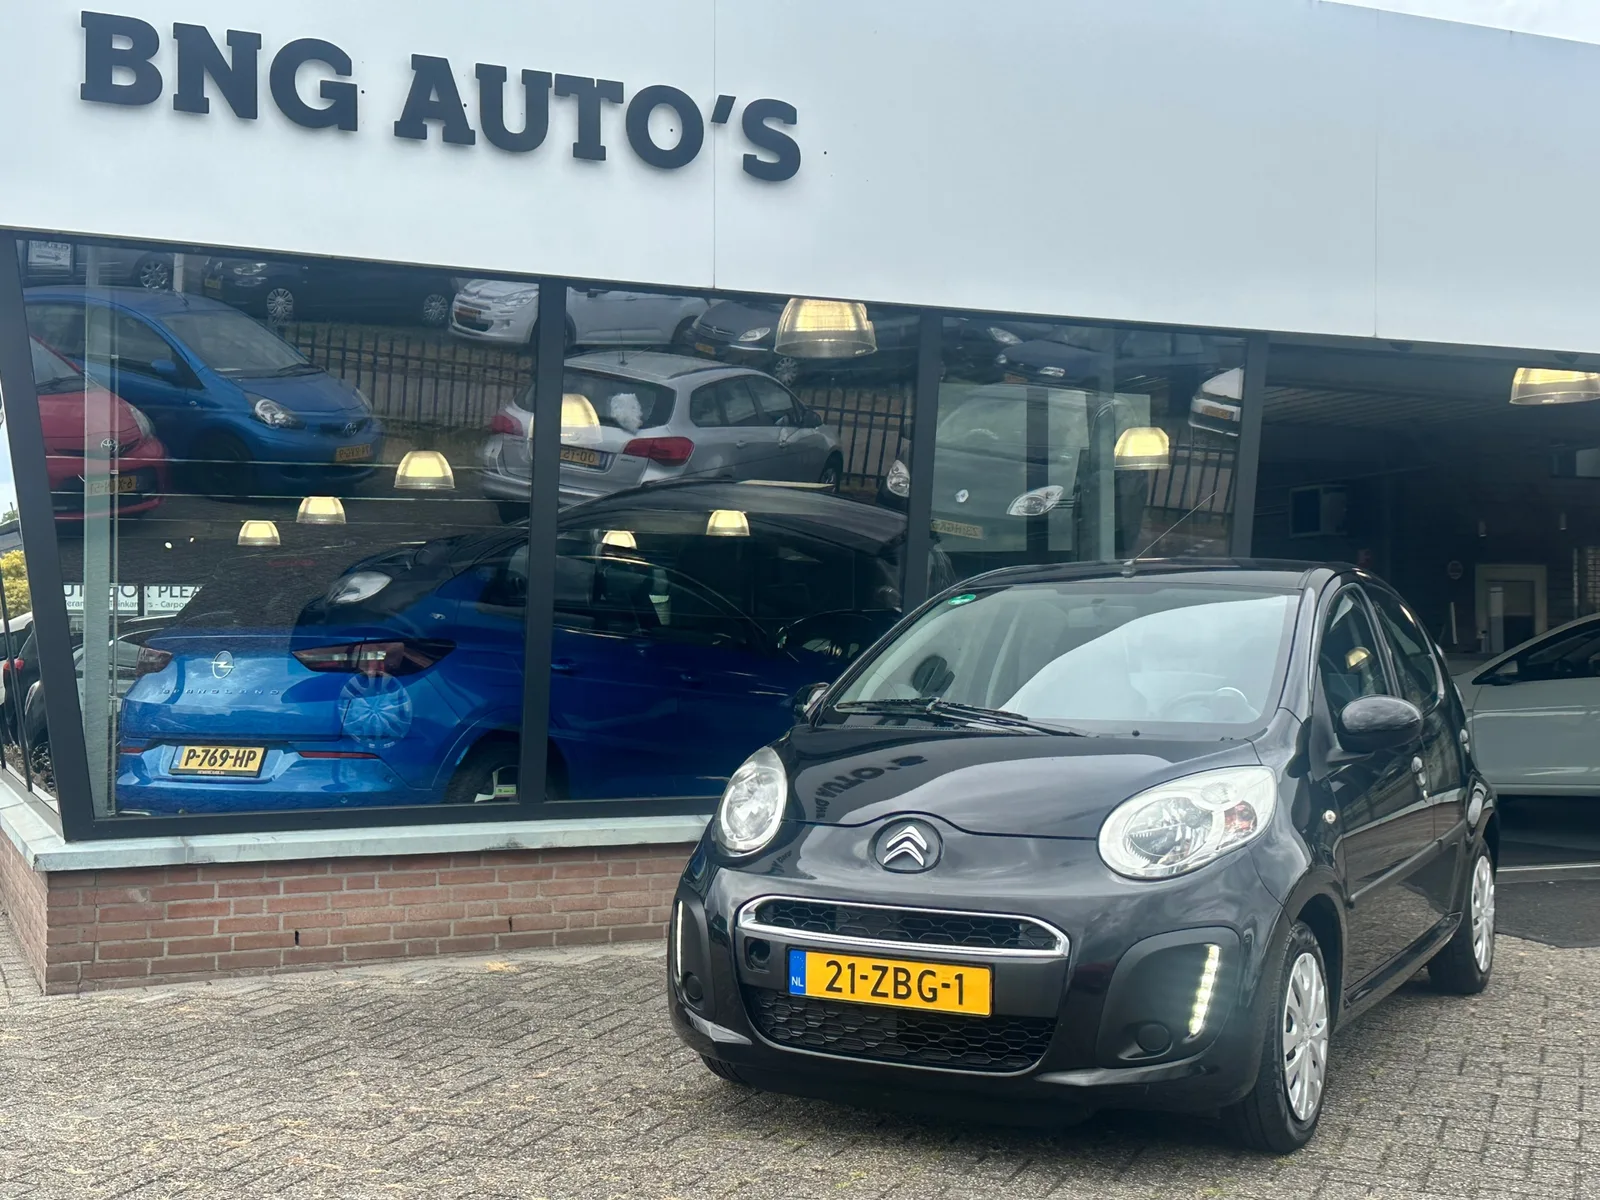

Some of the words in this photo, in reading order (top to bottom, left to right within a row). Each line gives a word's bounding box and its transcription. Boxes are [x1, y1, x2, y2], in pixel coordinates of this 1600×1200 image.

[80, 10, 358, 132] BNG
[394, 53, 801, 182] AUTO'S
[184, 748, 257, 769] P-769-HP
[791, 976, 804, 988] NL
[825, 959, 964, 1006] 21-ZBG-1
